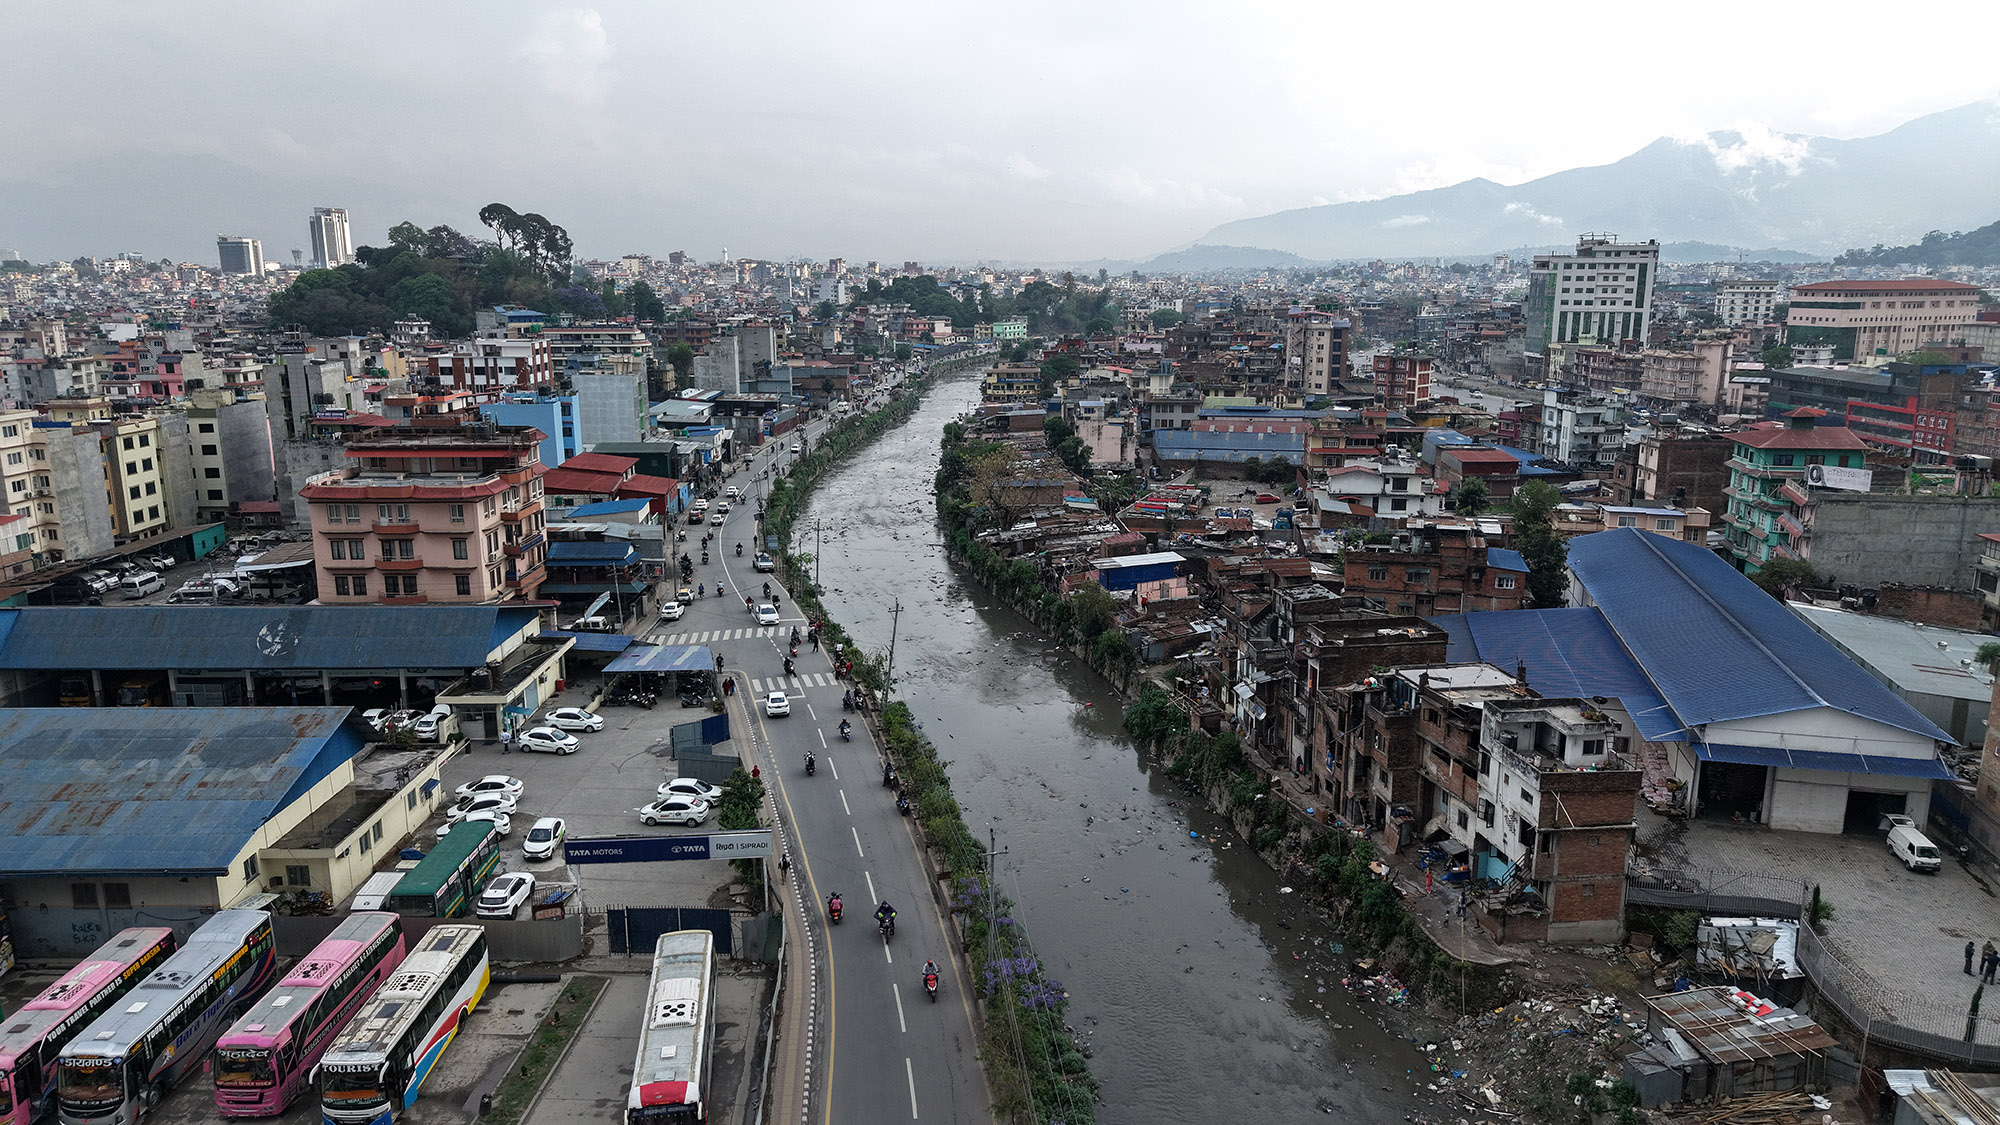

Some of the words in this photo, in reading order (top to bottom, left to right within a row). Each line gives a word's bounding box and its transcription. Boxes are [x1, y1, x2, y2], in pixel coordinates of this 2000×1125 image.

[682, 845, 705, 853] TATA
[740, 842, 768, 850] SIPRADI
[592, 848, 623, 856] MOTORS
[146, 1022, 164, 1042] YOUR
[163, 1006, 184, 1027] TRAVEL
[184, 985, 208, 1009] PARTNER
[213, 964, 227, 980] NEW
[225, 944, 249, 970] DIAMOND
[47, 1023, 66, 1043] YOUR
[66, 1006, 89, 1027] TRAVEL
[89, 985, 116, 1009] PARTNER
[122, 962, 141, 980] SUPER
[322, 1064, 380, 1073] TOURIST
